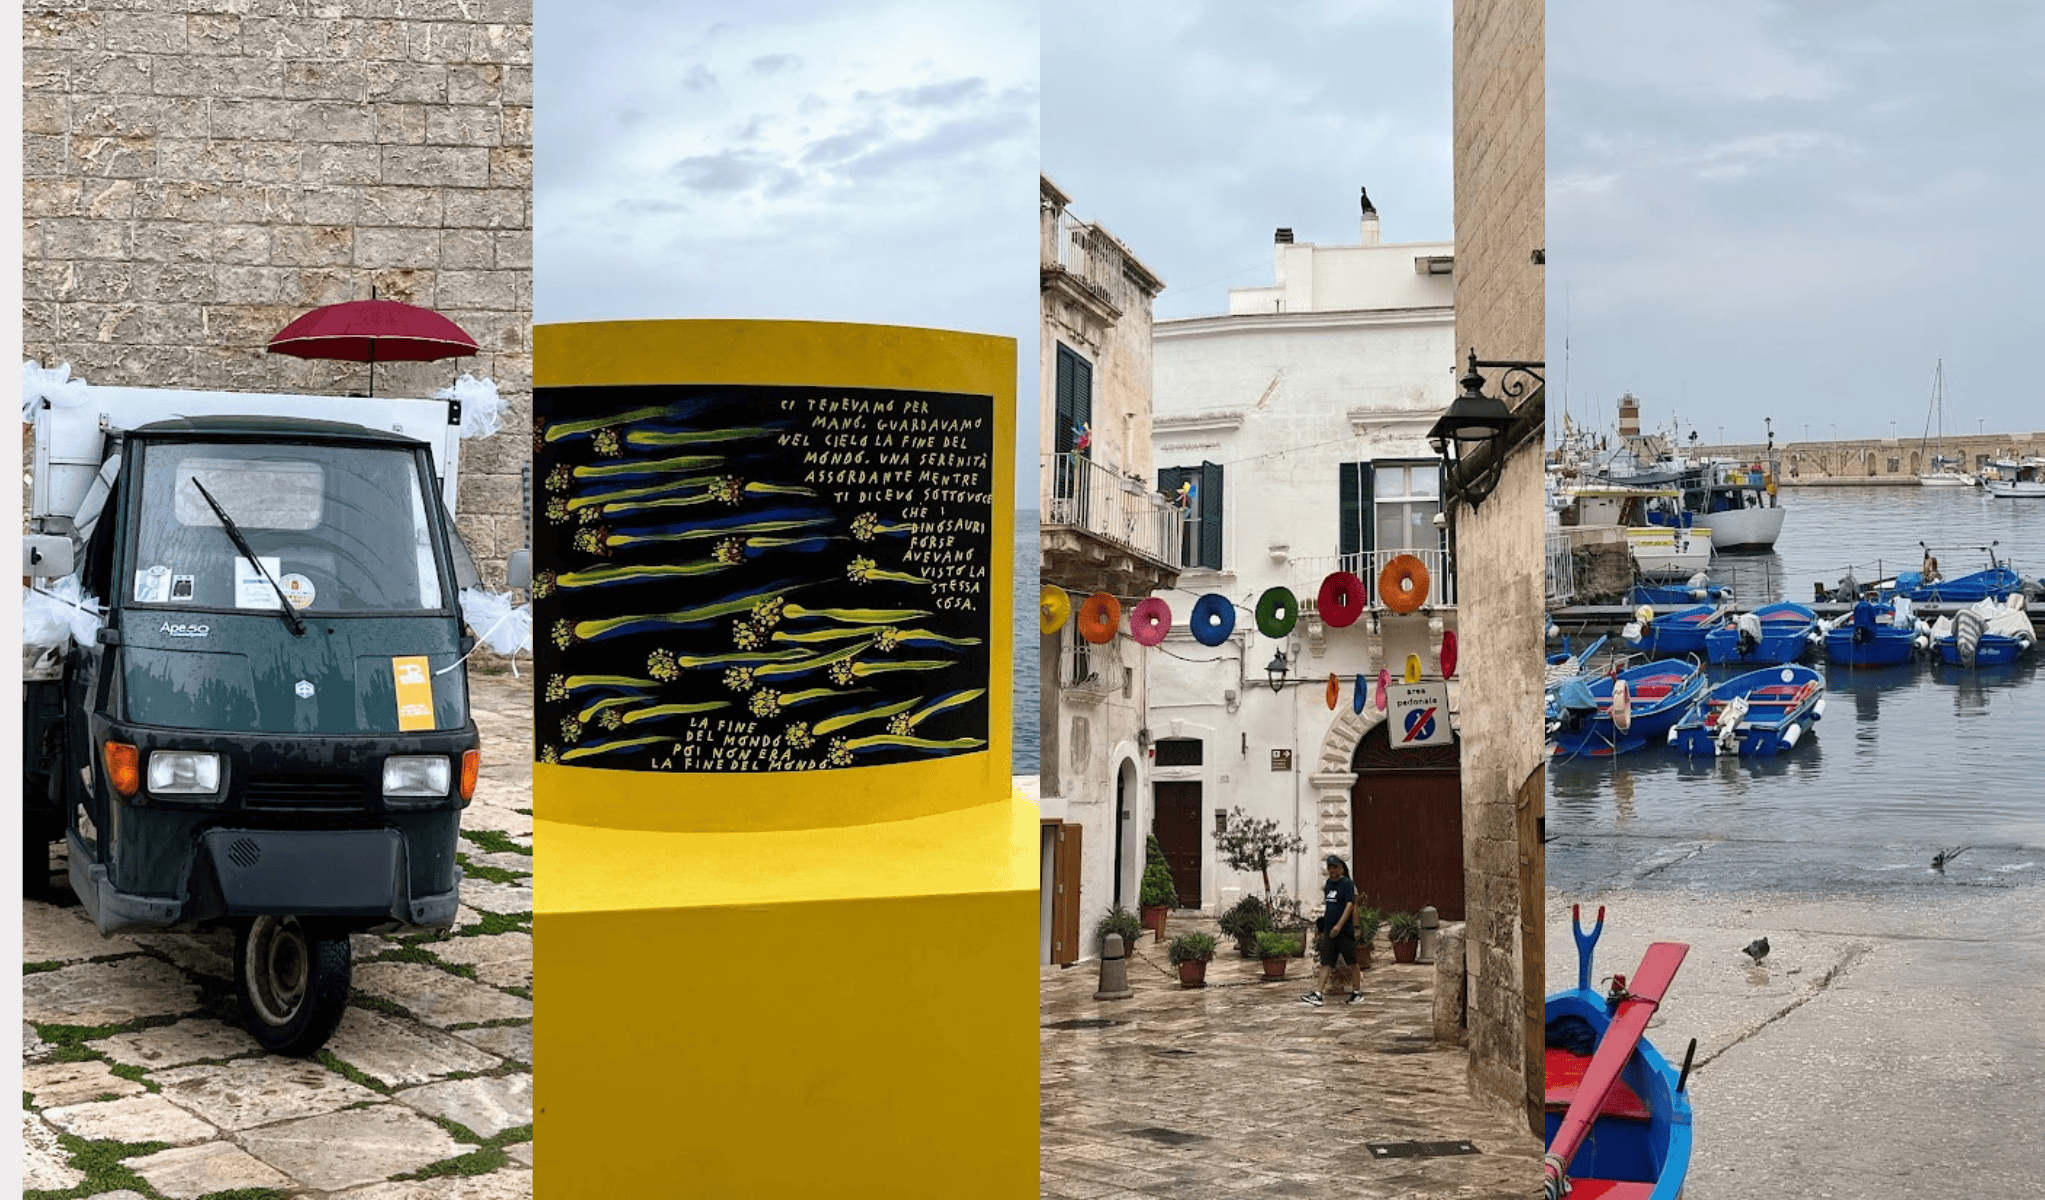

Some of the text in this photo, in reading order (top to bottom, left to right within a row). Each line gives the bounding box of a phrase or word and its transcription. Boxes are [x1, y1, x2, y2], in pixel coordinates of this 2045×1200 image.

[780, 398, 929, 415] CI TENEVAMO PER
[811, 415, 982, 433] MANO. GUARDAVAMO
[777, 433, 968, 450] NEL CIELO LA FINE DEL
[803, 452, 870, 465] MONDO.
[880, 452, 910, 466] UNA
[804, 469, 979, 487] ASSORDANTE MENTRE
[833, 488, 993, 506] TI DICEVO SOTTOVOCE
[901, 505, 929, 519] CHE
[909, 535, 956, 550] FORSE
[902, 548, 975, 563] AVEVANO
[920, 564, 986, 578] VISTO LA
[930, 579, 981, 595] STESSA
[1397, 697, 1437, 707] pedonale
[690, 717, 757, 733] LA FINE
[686, 729, 783, 748] DEL MONDO
[672, 743, 792, 761] POI NON ERA
[651, 757, 673, 770] LA
[684, 759, 725, 770] FINE
[730, 760, 760, 772] DEL
